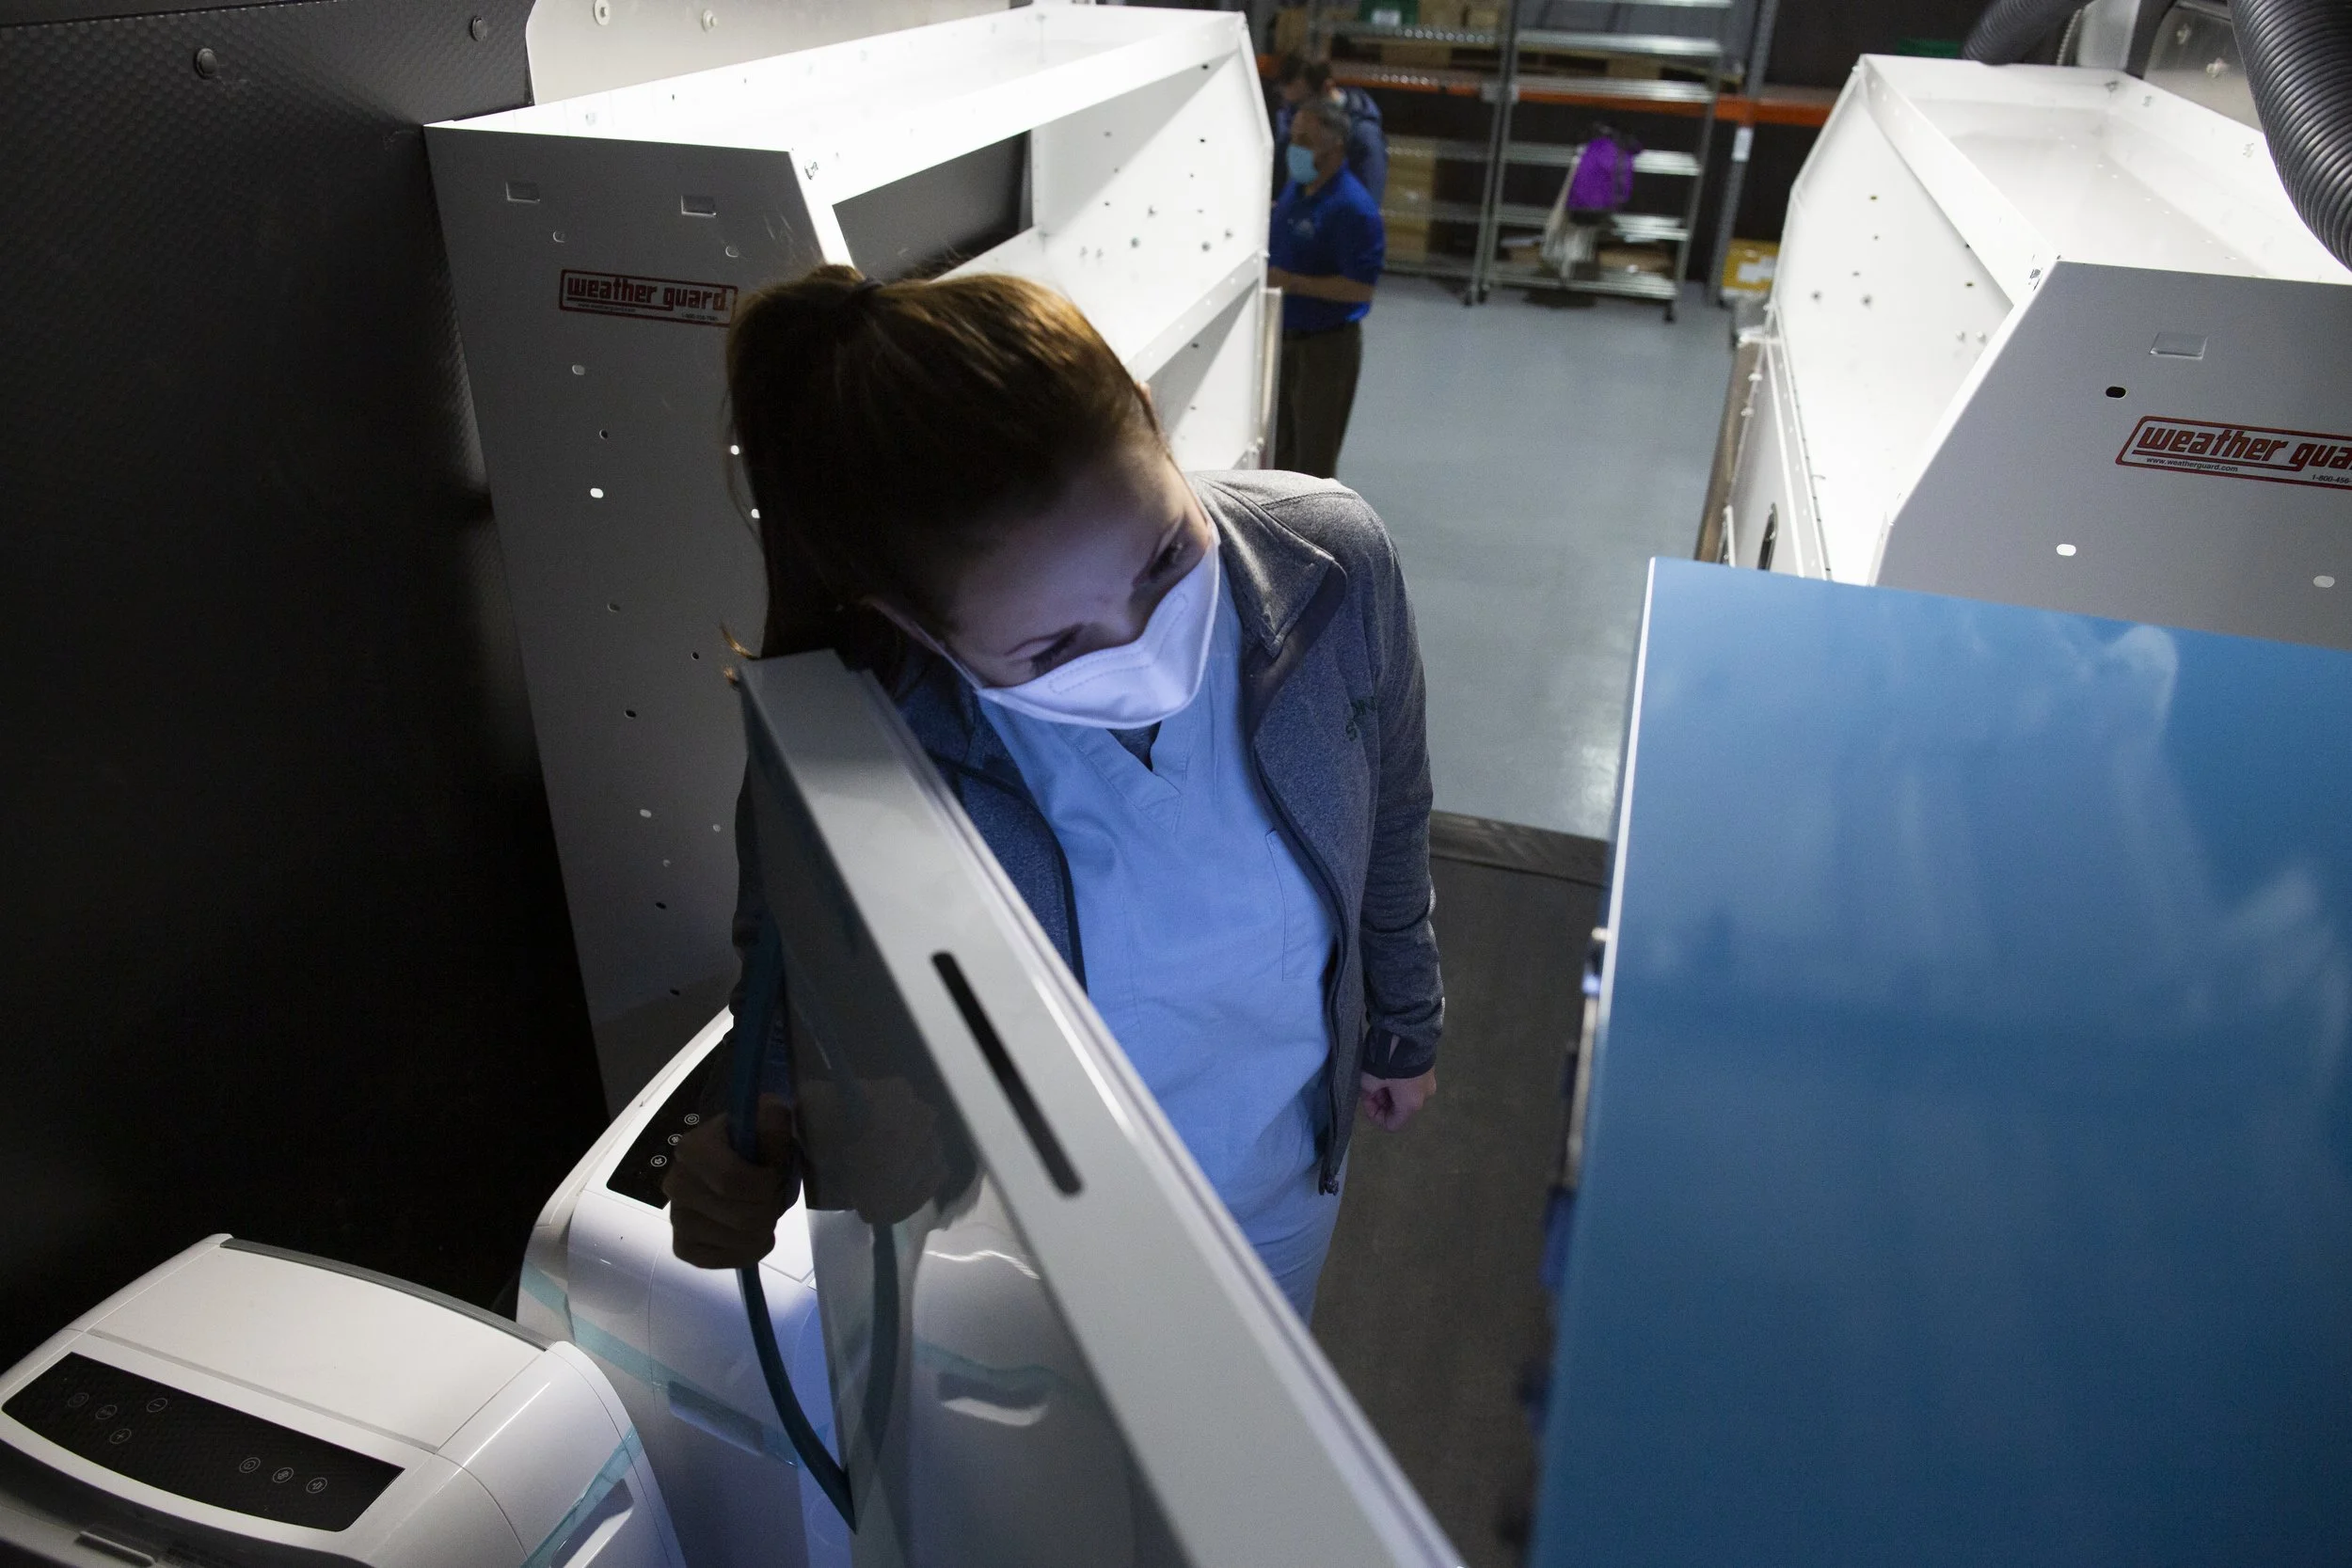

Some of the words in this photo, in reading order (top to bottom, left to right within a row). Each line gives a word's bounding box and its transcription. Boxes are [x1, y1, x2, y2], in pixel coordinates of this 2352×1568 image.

[566, 277, 658, 304] weather
[662, 286, 727, 311] guard
[2136, 426, 2289, 462] weather
[2288, 442, 2352, 472] gua
[2146, 456, 2238, 472] www.weatherguard.com
